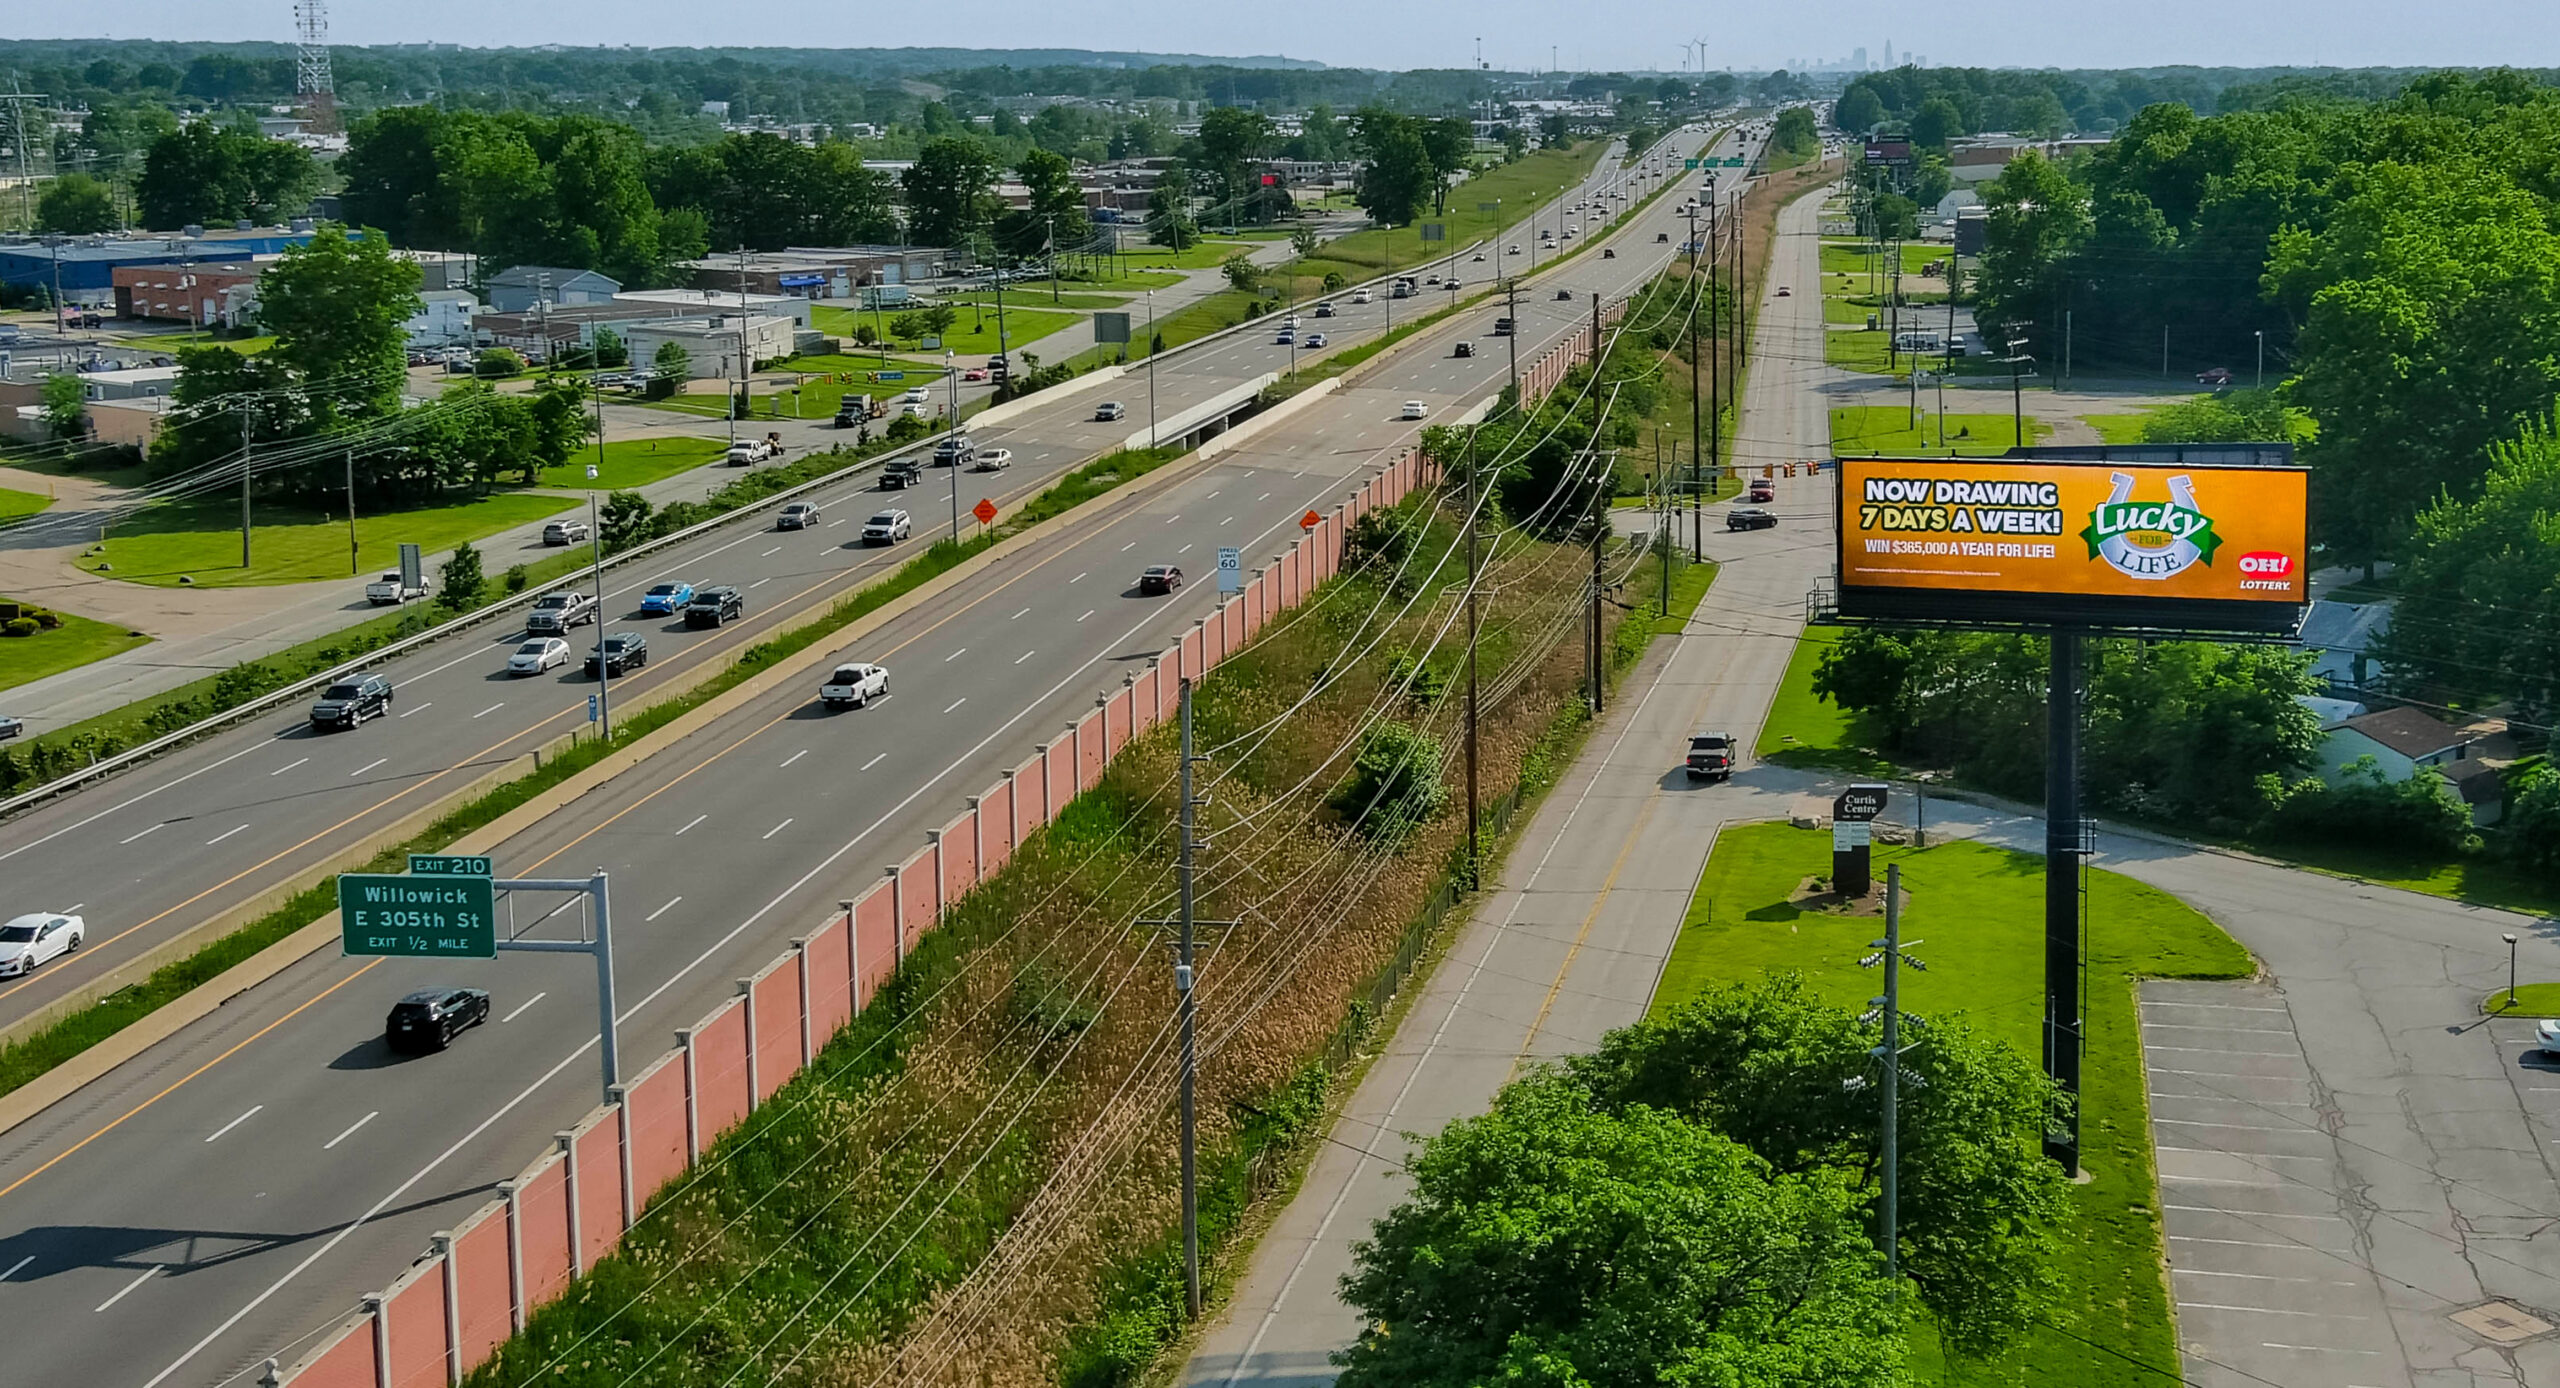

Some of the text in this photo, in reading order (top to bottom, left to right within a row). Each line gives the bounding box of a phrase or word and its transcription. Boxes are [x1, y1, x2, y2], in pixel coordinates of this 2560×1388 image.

[1866, 480, 2057, 505] NOW DRAWING
[1861, 507, 2061, 534] 7 DAYS A WEEK!
[2096, 502, 2208, 540] Lucky
[1865, 539, 2056, 558] WIN $365,000 A YEAR FOR LIFE!
[2138, 535, 2162, 545] FOR
[1221, 559, 1236, 568] 60
[2116, 550, 2181, 574] LIFE
[2239, 556, 2289, 573] OH!
[1845, 795, 1877, 804] Curtis
[1844, 804, 1877, 813] Centre
[416, 859, 485, 874] EXIT 210
[365, 886, 468, 904] Willowick
[355, 911, 480, 928] E 305th St
[368, 937, 397, 948] EXIT
[438, 938, 469, 949] MILE
